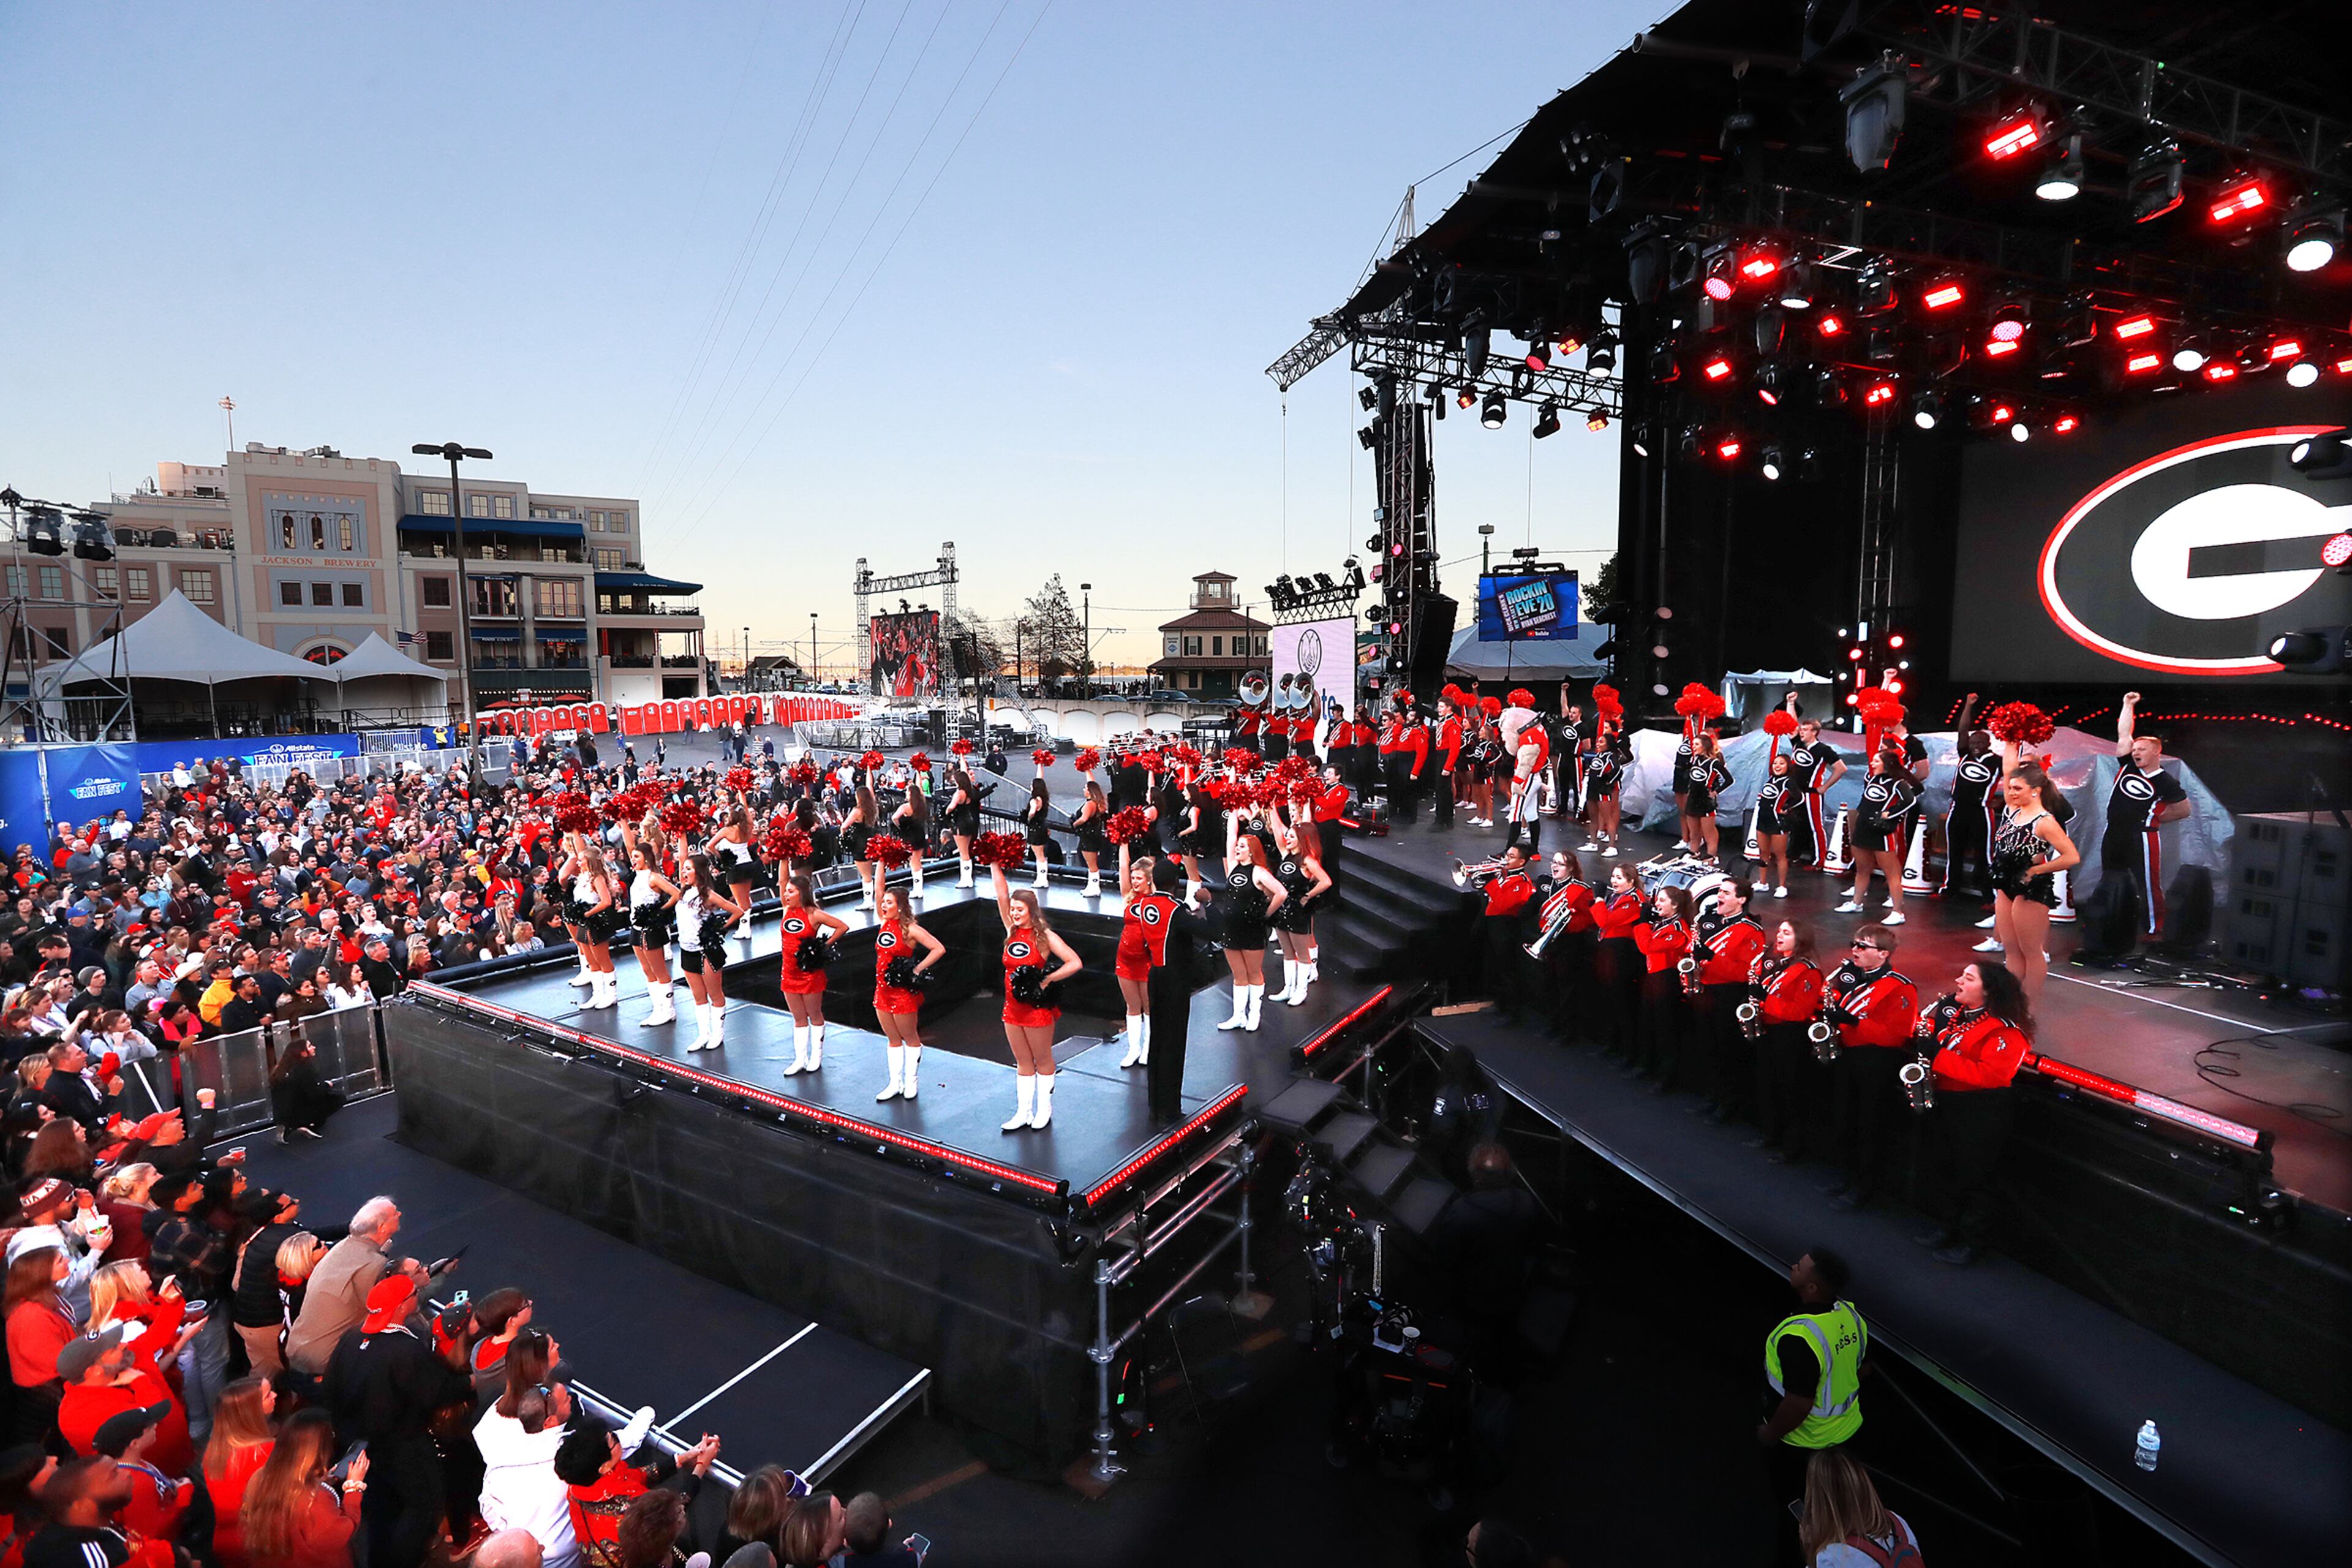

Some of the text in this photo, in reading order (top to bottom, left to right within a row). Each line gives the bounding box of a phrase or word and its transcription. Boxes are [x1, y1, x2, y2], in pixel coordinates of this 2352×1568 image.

[261, 556, 377, 567] JACKSON BREWERY
[1533, 611, 1557, 625] SEACREST
[255, 751, 331, 765] FAN FEST
[1793, 748, 1813, 766] G
[1690, 766, 1708, 781] G
[1959, 761, 1990, 782] G
[77, 783, 121, 799] FAN FEST
[1762, 783, 1779, 799] G
[1865, 784, 1888, 801] G
[2120, 774, 2154, 799] G
[1747, 839, 1758, 848] G
[1280, 862, 1295, 874] G
[1902, 869, 1917, 879] G
[1229, 873, 1248, 886] G
[1143, 904, 1159, 925] G
[784, 918, 804, 933] G
[877, 932, 896, 947] G
[1008, 942, 1030, 959] G
